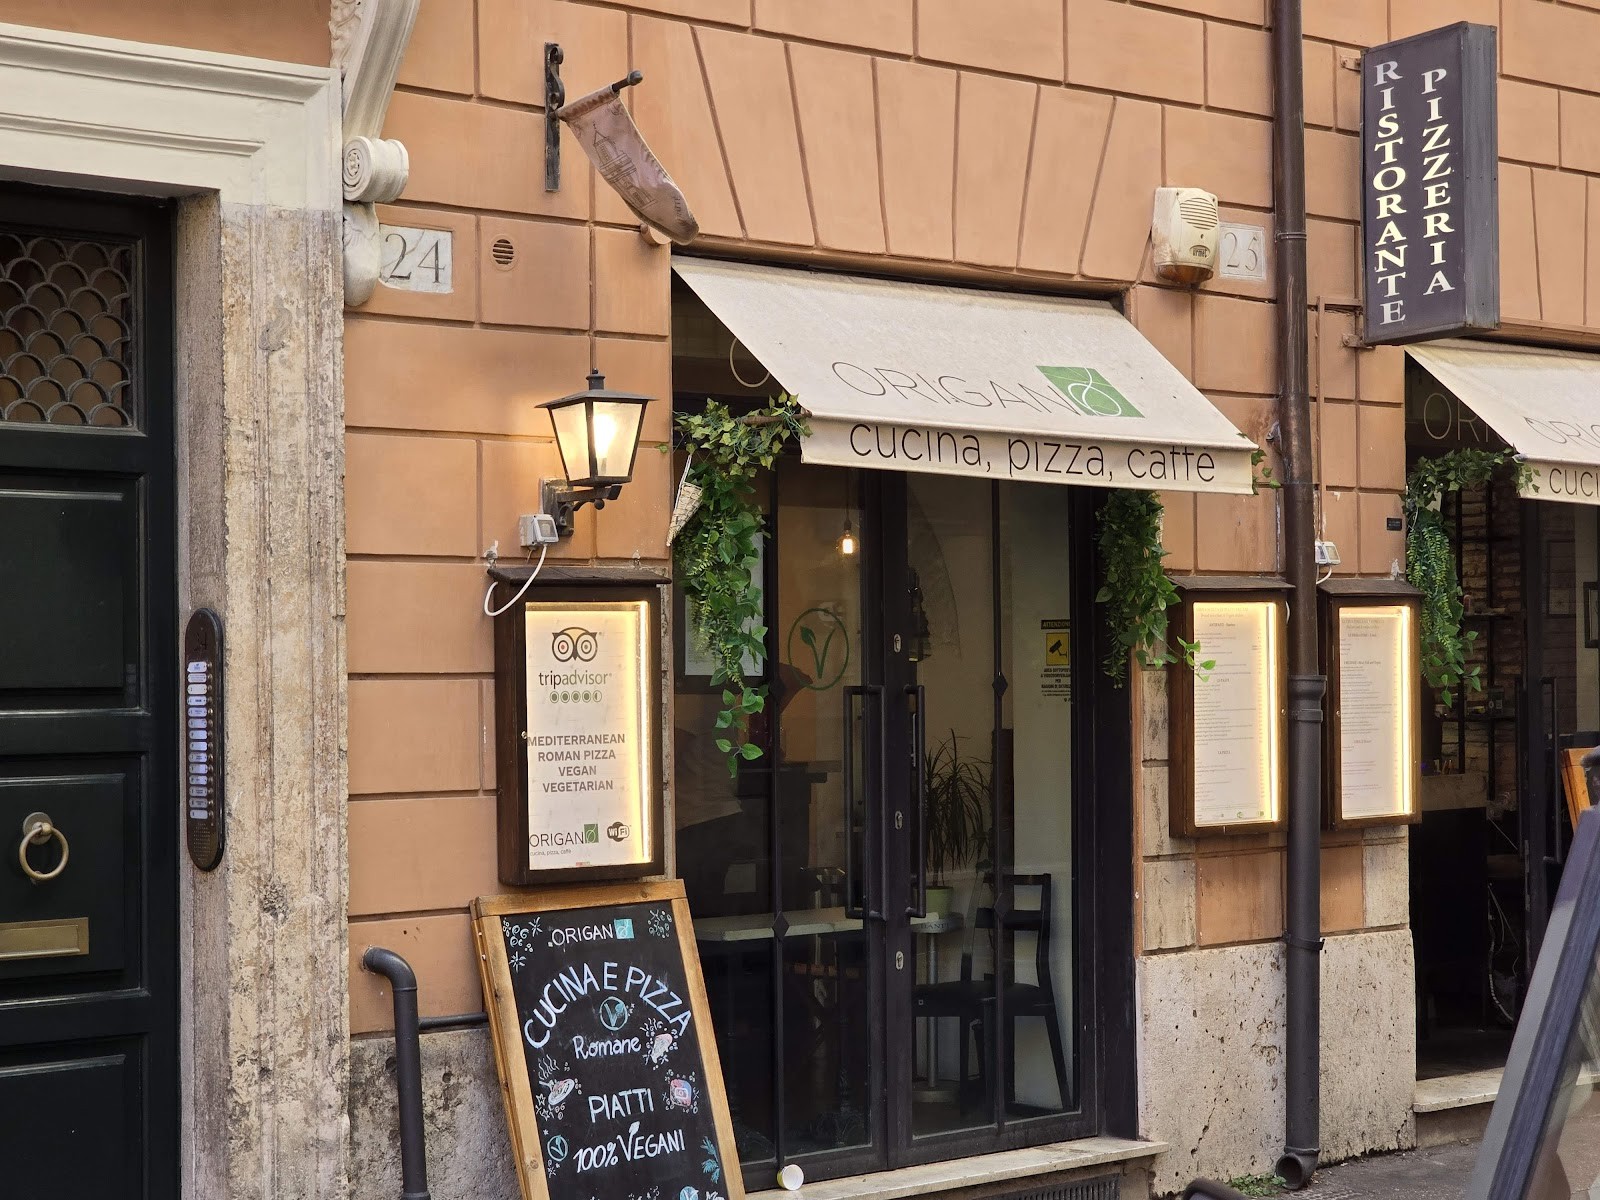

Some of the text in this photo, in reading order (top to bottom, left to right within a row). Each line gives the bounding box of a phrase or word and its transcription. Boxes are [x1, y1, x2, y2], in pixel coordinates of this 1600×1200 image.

[1373, 61, 1408, 325] RISTORANTE
[1421, 68, 1455, 295] PIZZERIA
[384, 233, 446, 284] 24
[1223, 231, 1258, 272] 25
[850, 423, 991, 473] cucina,
[1008, 438, 1113, 482] pizza,
[538, 669, 609, 689] tripadvisor
[527, 733, 626, 747] MEDITERRANEAN
[538, 749, 616, 762] ROMAN PIZZA
[542, 780, 614, 793] VEGETARIAN
[558, 765, 597, 777] VEGAN
[523, 961, 692, 1049] CUCINA E PIZZA
[572, 1035, 642, 1060] Romane
[588, 1087, 655, 1123] PIATTI
[572, 1122, 686, 1174] 100% VEGANI
